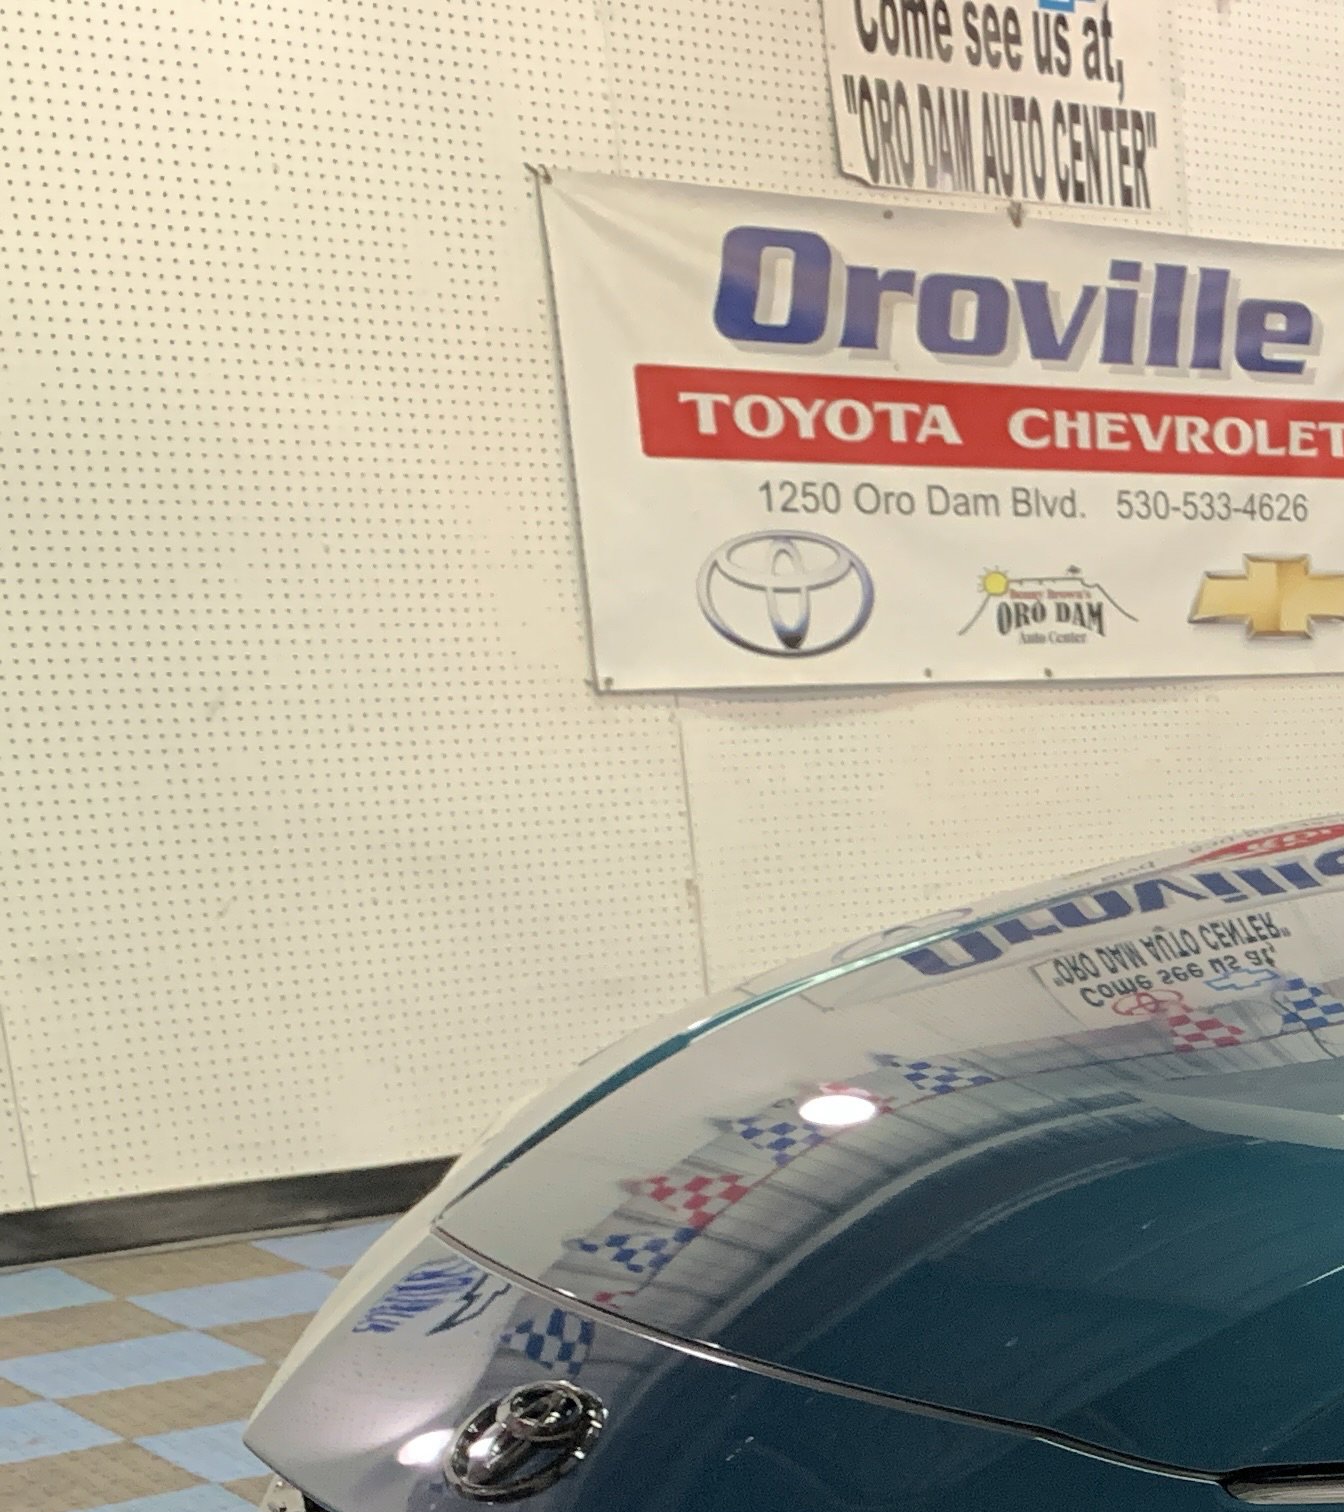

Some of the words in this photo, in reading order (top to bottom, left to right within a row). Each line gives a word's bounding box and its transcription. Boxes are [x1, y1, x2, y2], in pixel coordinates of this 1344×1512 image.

[855, 0, 953, 63] Come
[963, 2, 1023, 72] see
[1032, 11, 1073, 78] us
[1083, 2, 1125, 105] at,
[842, 74, 914, 188] "ORO
[917, 83, 976, 193] DAM
[982, 91, 1046, 201] AUTO
[1053, 100, 1157, 209] CENTER"
[713, 225, 1315, 378] Oroville
[679, 391, 962, 447] TOYOTA
[758, 479, 842, 516] 1250
[853, 482, 917, 518] Oro
[927, 484, 1000, 520] Dam
[1011, 486, 1087, 522] Blvd.
[1116, 489, 1310, 524] 530-533-4626
[996, 601, 1047, 636] ORO
[1055, 601, 1106, 637] DAM
[1048, 631, 1087, 645] Center
